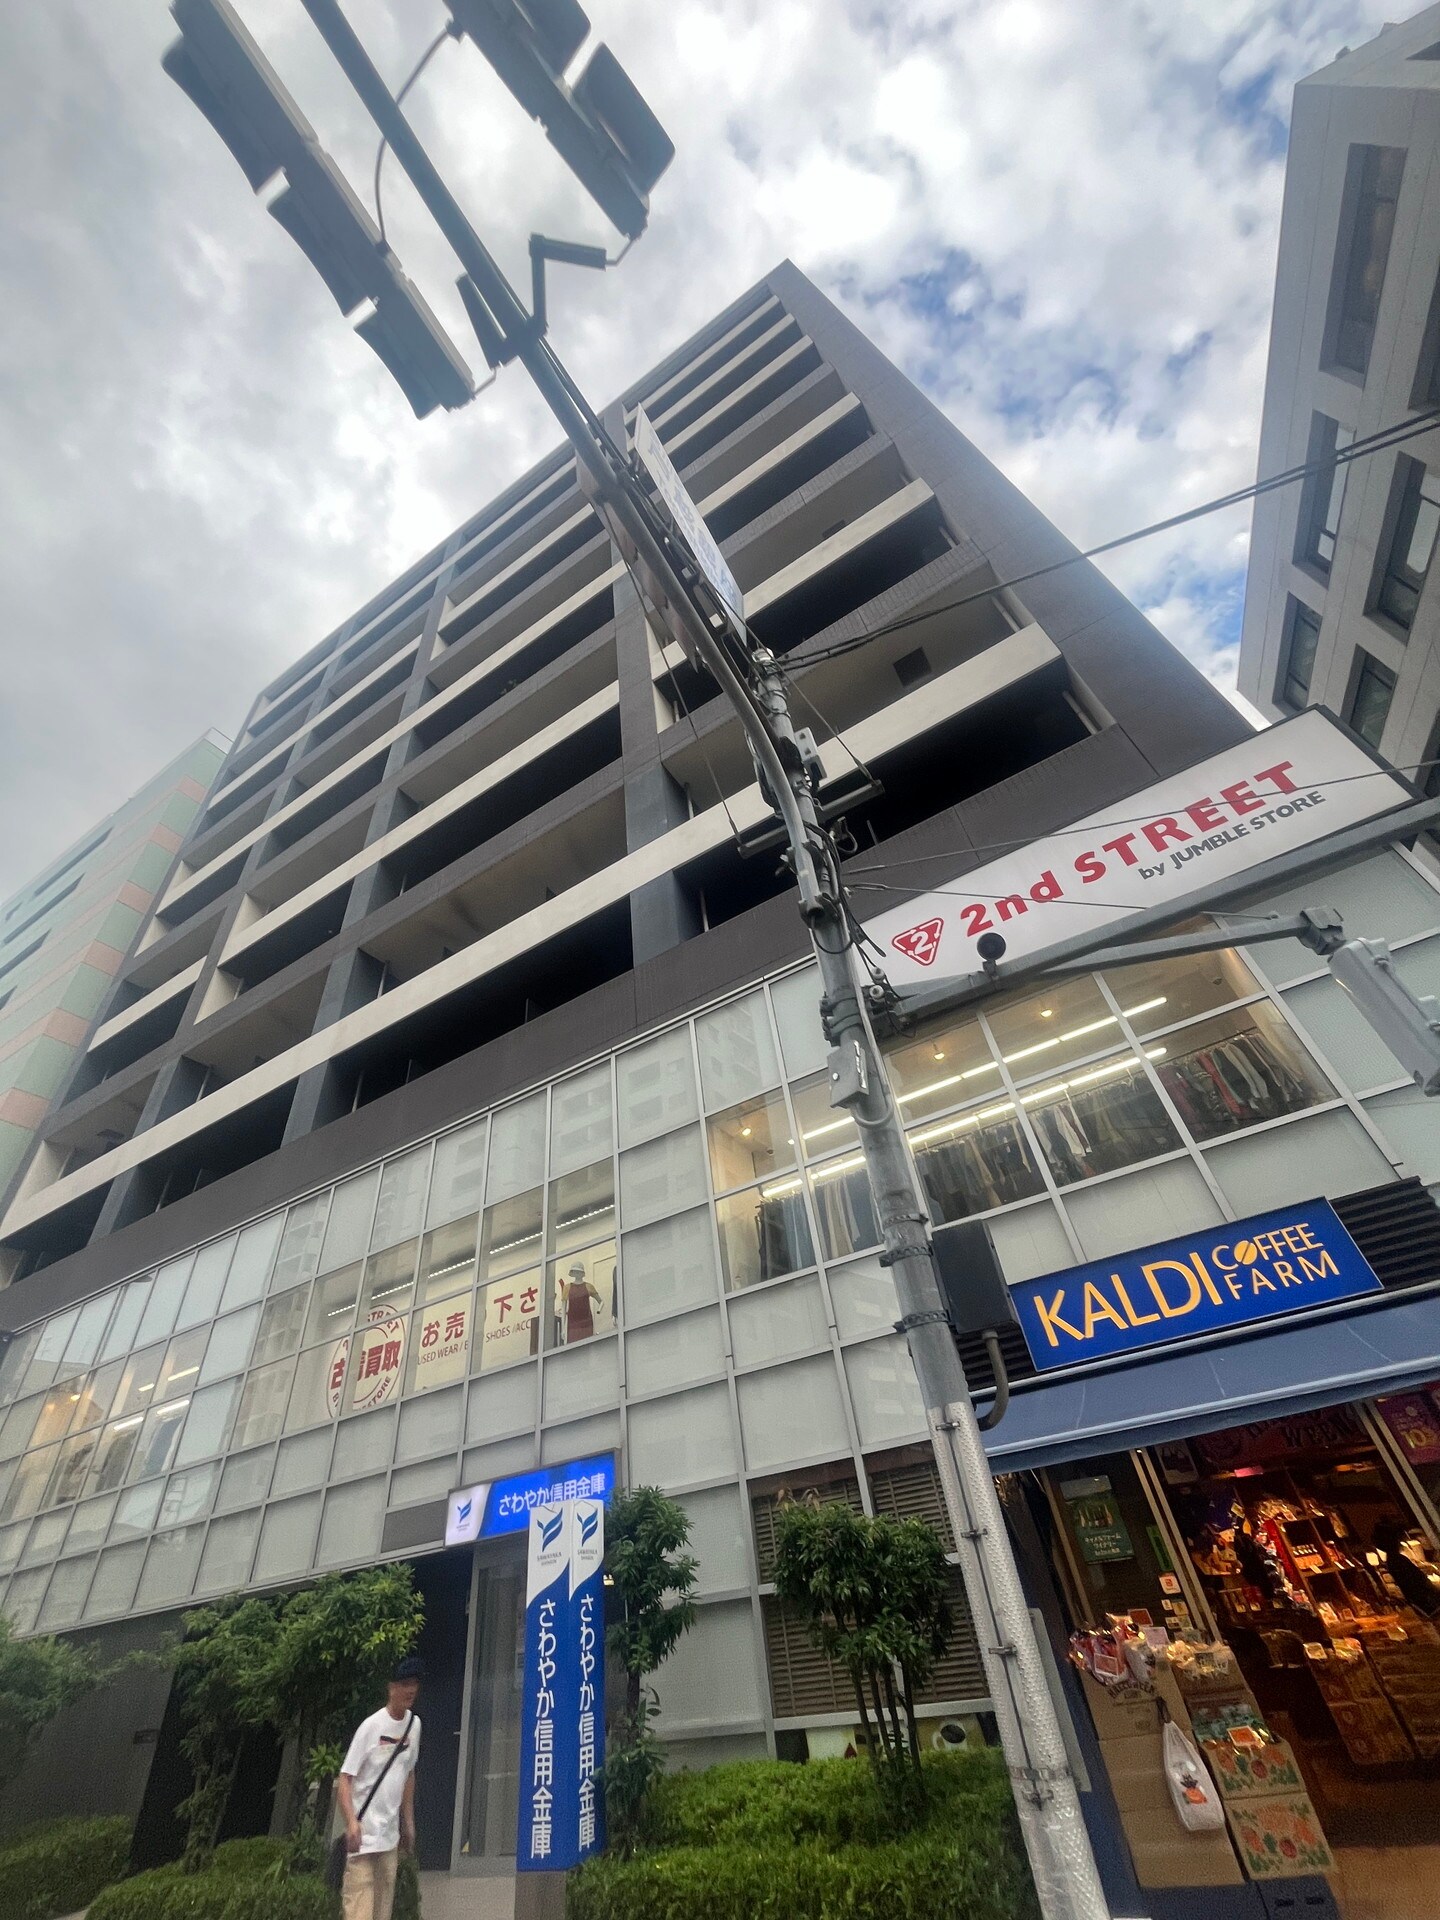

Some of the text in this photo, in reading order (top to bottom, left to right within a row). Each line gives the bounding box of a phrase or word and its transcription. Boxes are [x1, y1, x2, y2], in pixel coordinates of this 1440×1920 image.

[960, 760, 1300, 937] 2nd STREET
[1138, 789, 1327, 881] by JUMBLE STORE
[1211, 1222, 1325, 1272] COFFEE
[1223, 1249, 1341, 1301] FARM
[486, 1325, 511, 1344] SHOES
[1032, 1251, 1224, 1347] KALDI
[437, 1343, 458, 1360] WEAR
[498, 1471, 606, 1518] さわやか信用金庫
[530, 1597, 556, 1860] さわやか信用金庫
[578, 1592, 596, 1853] さわやか信用金庫
